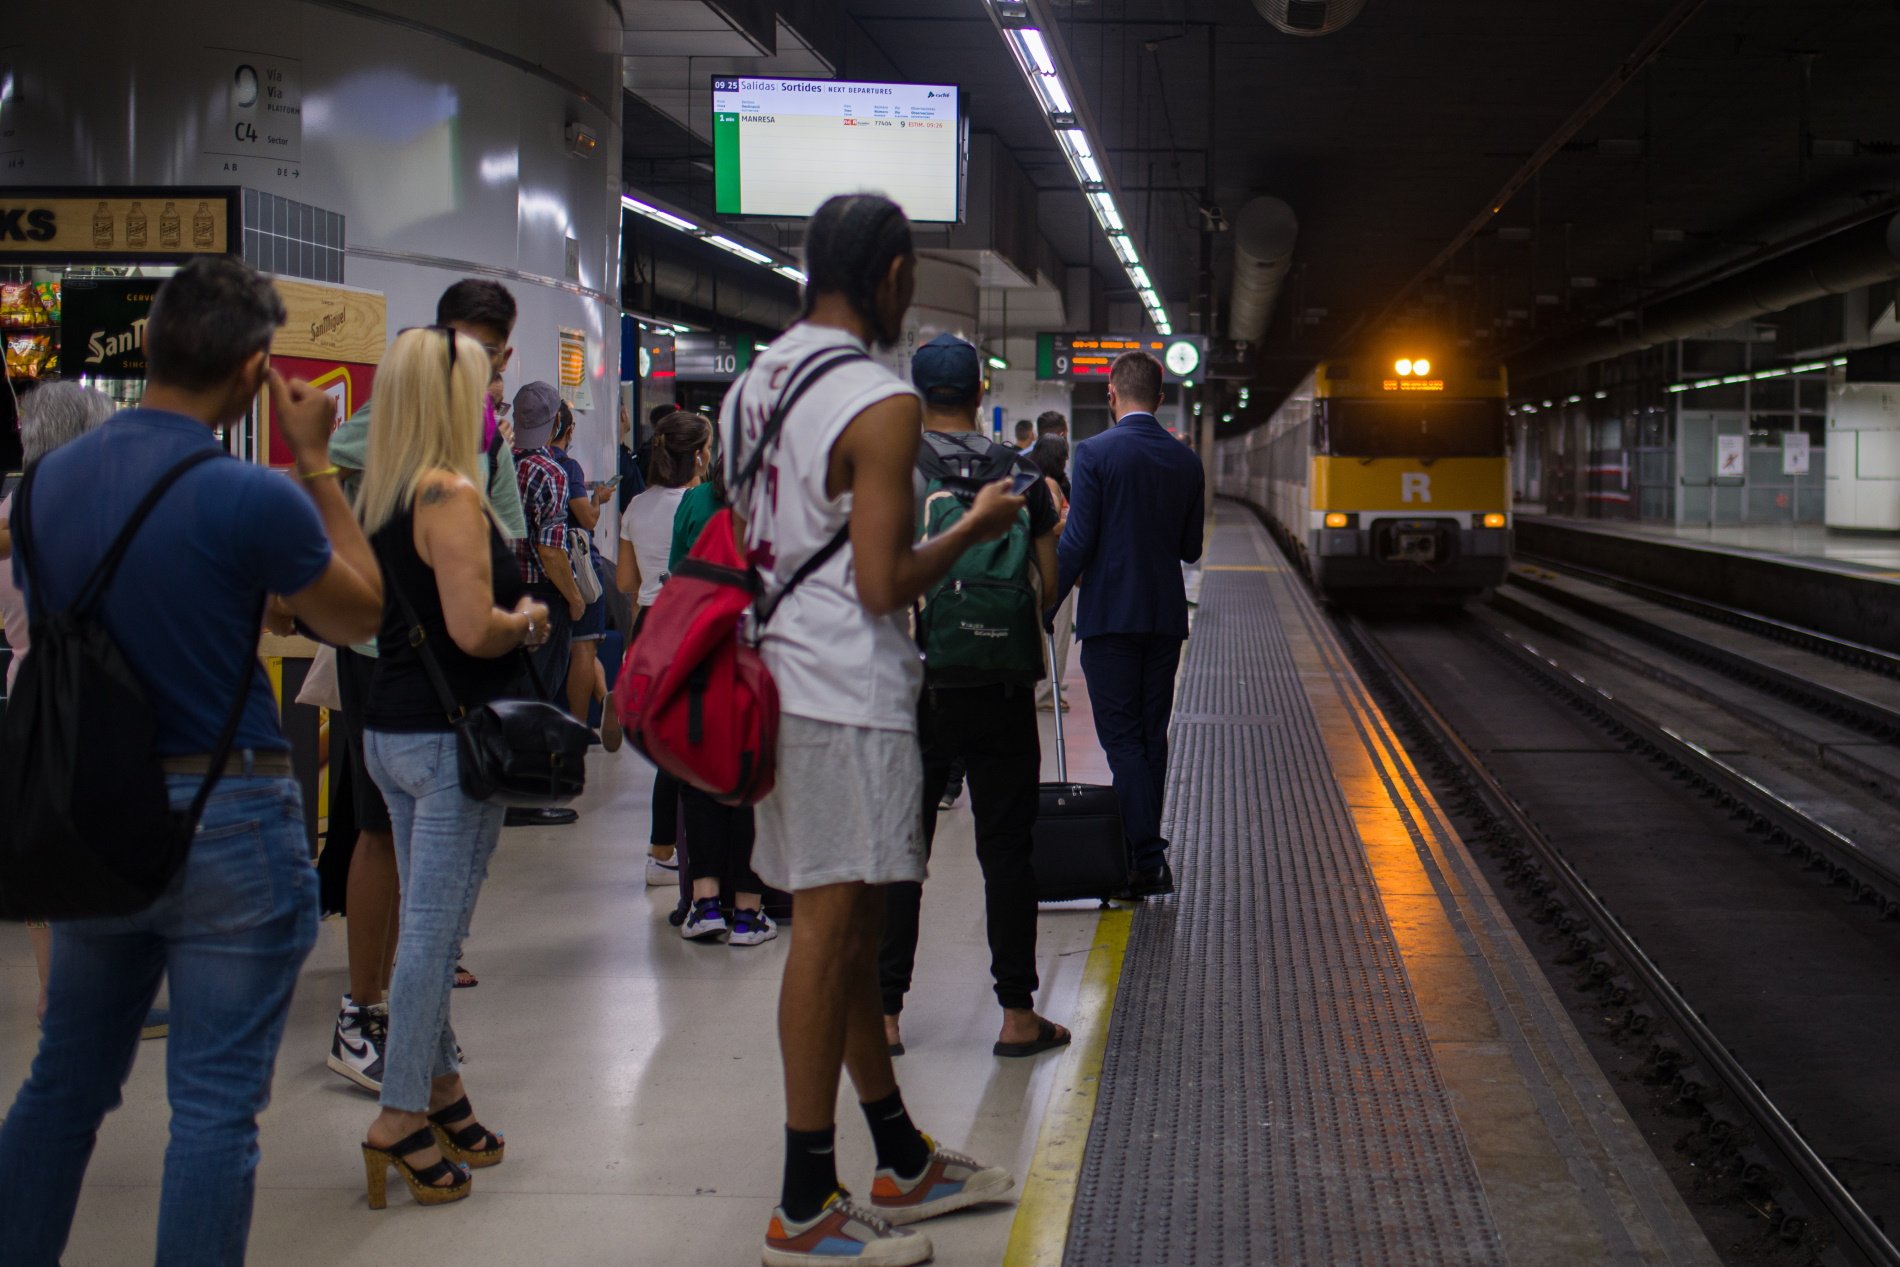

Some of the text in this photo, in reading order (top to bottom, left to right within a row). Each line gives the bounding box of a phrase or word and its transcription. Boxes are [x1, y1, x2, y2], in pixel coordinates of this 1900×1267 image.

[234, 64, 259, 108] 9
[267, 86, 282, 99] Via
[714, 81, 725, 89] 09
[741, 81, 775, 91] Salidas
[781, 82, 822, 93] Sortides
[848, 87, 893, 95] DEPARTURES
[267, 104, 300, 115] PLATFORM
[719, 114, 725, 122] 1
[741, 115, 776, 123] MANRESA
[900, 120, 906, 128] 9
[234, 122, 258, 142] C4
[267, 135, 289, 145] Sector
[714, 354, 736, 373] 10
[1056, 356, 1068, 374] 9
[1401, 471, 1431, 503] R
